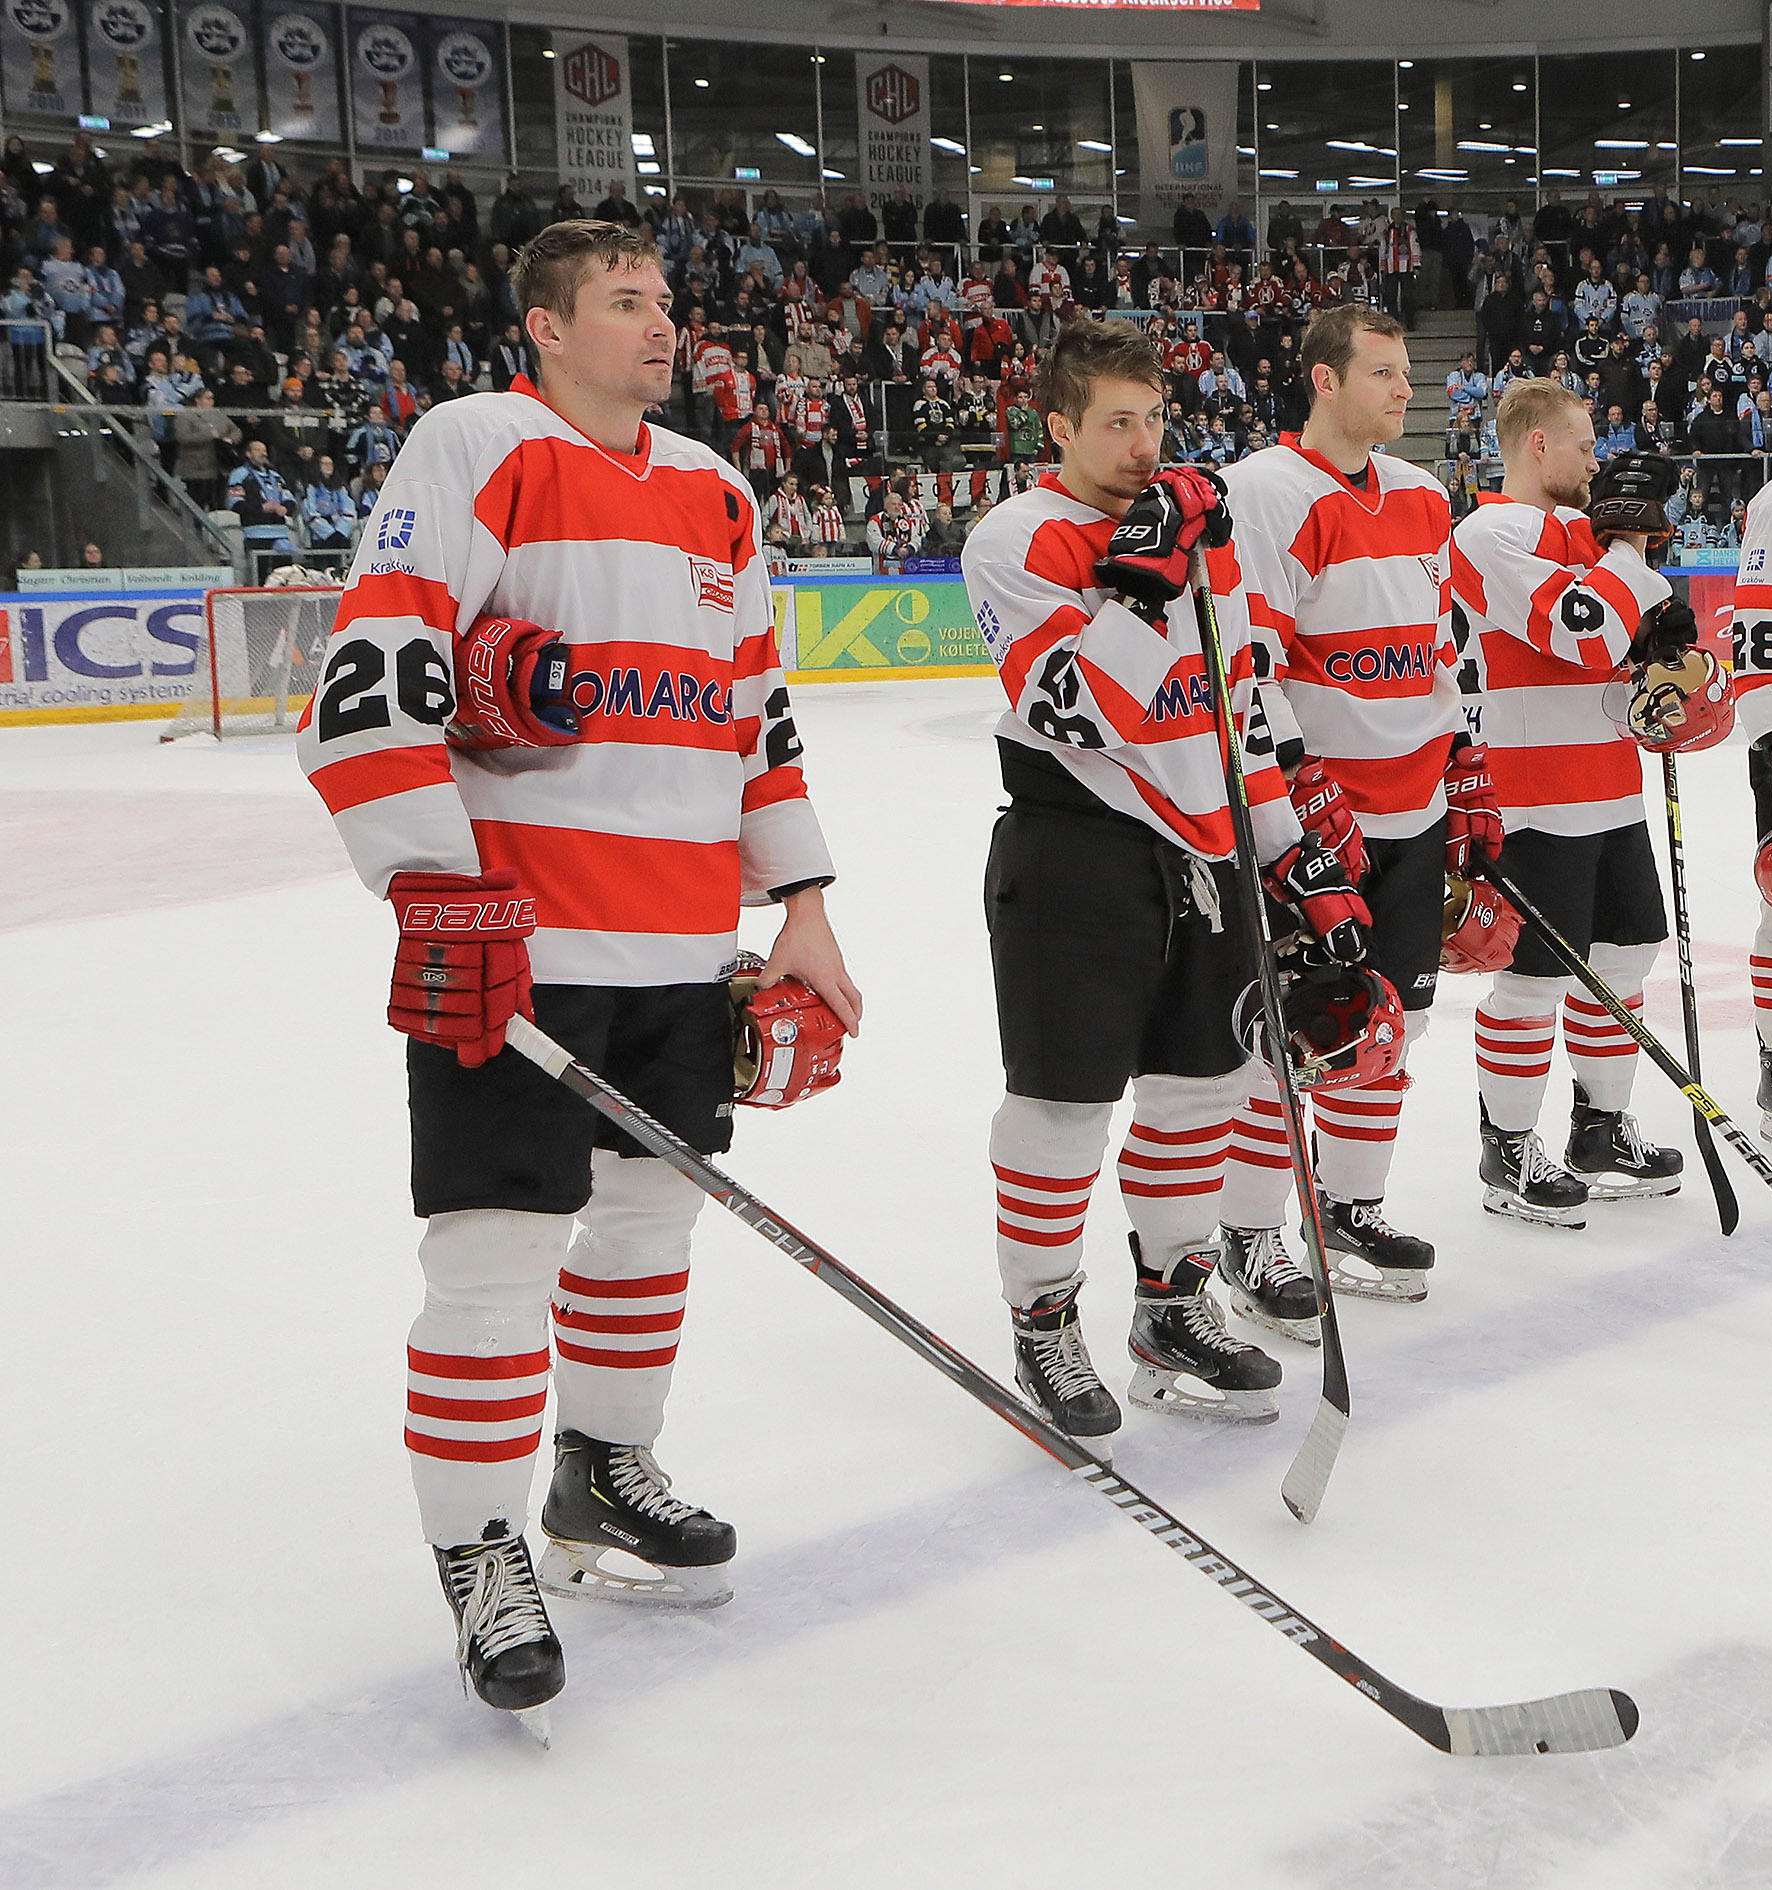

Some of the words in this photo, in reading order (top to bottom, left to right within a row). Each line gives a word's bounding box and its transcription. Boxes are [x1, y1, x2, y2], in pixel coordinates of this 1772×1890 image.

[568, 51, 616, 101] CHL
[871, 70, 915, 118] CHL
[567, 126, 623, 147] HOCKEY
[568, 149, 625, 169] LEAGUE
[868, 143, 921, 163] HOCKEY
[869, 164, 922, 184] LEAGUE
[1713, 558, 1739, 566] METAL
[938, 626, 983, 641] VOJEN
[938, 643, 989, 658] KØLETE
[40, 684, 112, 706] cooling
[119, 683, 194, 703] systems
[318, 636, 458, 744] 26
[568, 667, 734, 727] OMARC
[402, 897, 538, 932] BAUE
[1072, 1462, 1321, 1646] WARRIOR
